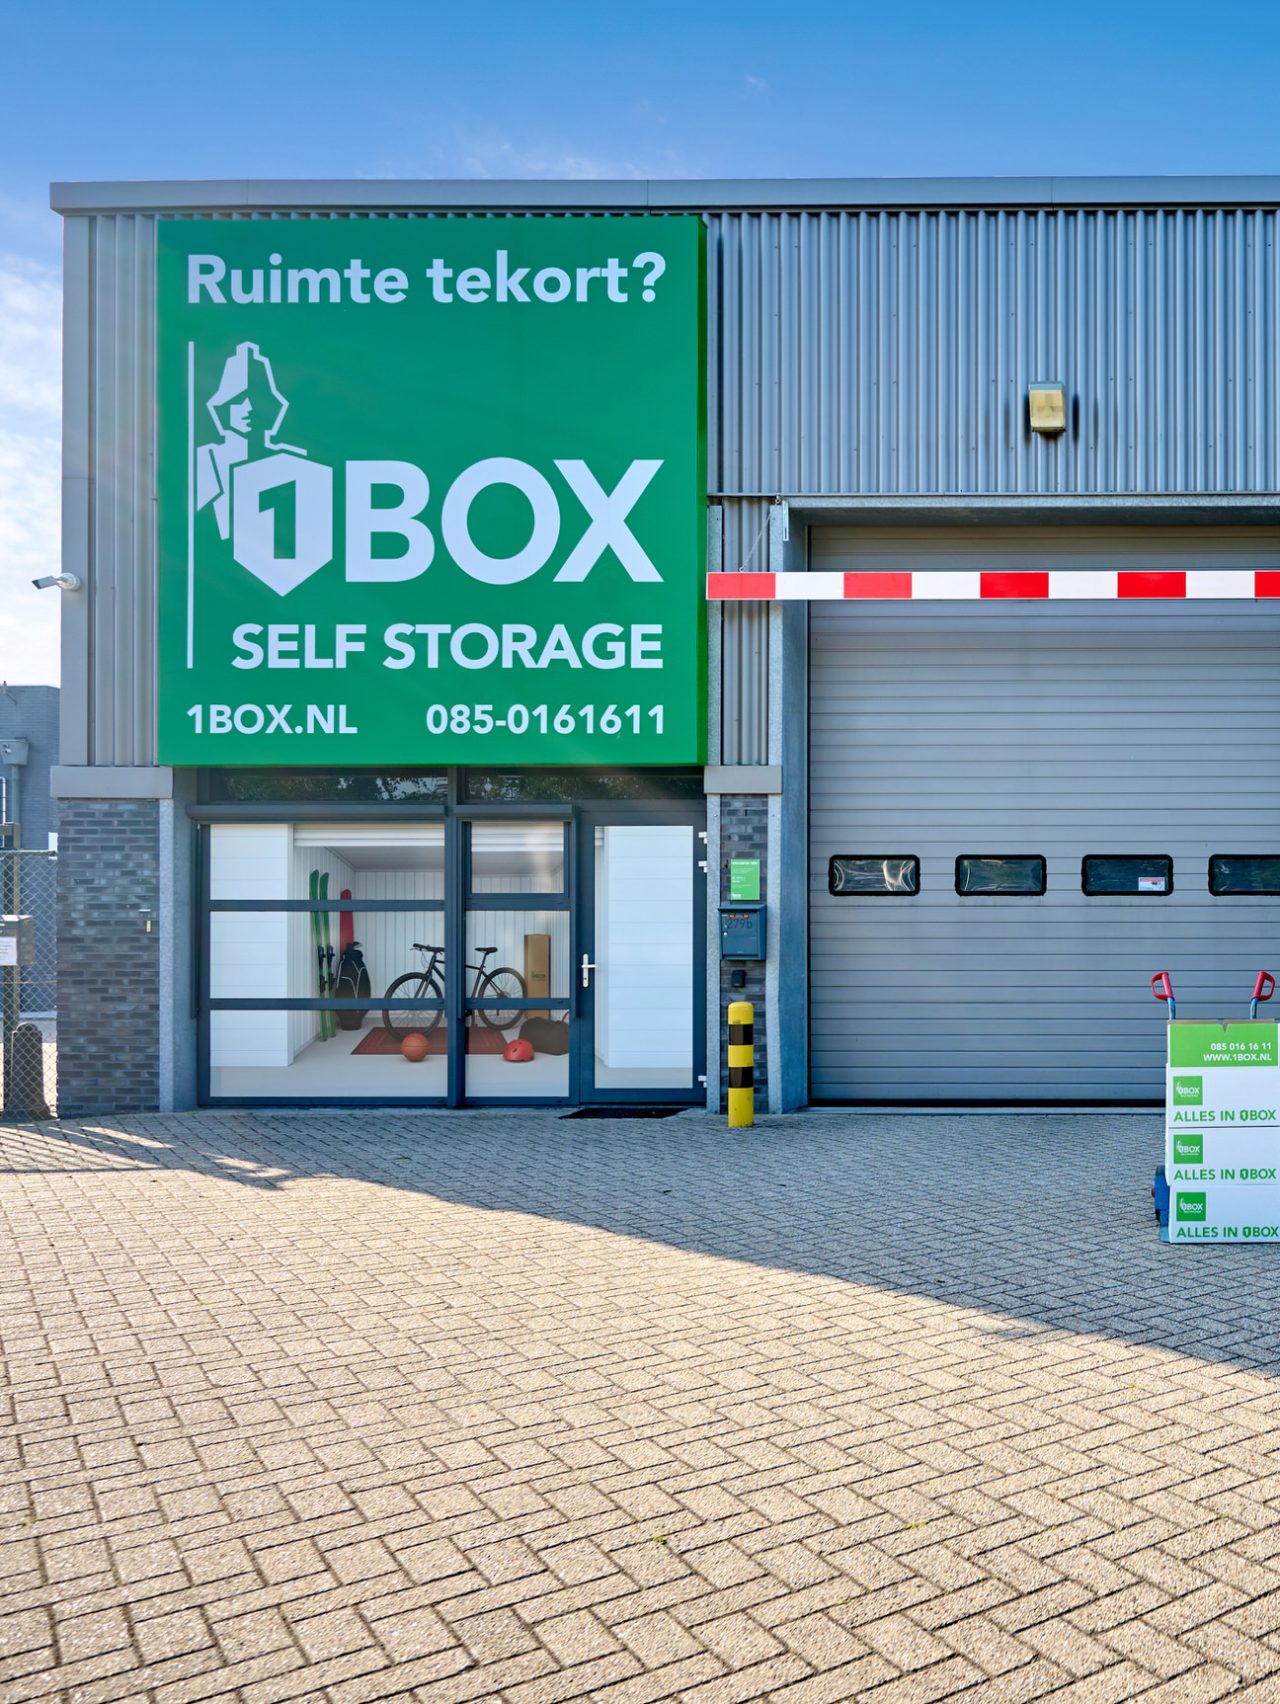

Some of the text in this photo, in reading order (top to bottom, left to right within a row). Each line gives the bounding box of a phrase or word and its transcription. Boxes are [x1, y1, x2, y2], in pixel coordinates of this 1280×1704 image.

[187, 249, 666, 304] Ruimte tekort?
[233, 453, 665, 597] 1BOX
[231, 622, 664, 670] SELF STORAGE
[187, 703, 665, 735] 1BOX.NL 085-0161611
[1210, 1042, 1272, 1051] 085 016 16 11
[1203, 1053, 1272, 1062] WWW.1BOX.NL
[1173, 1109, 1276, 1122] ALLES IN 1BOX
[1173, 1168, 1277, 1181] ALLES IN 1BOX
[1176, 1226, 1279, 1239] ALLES IN 1BOX
